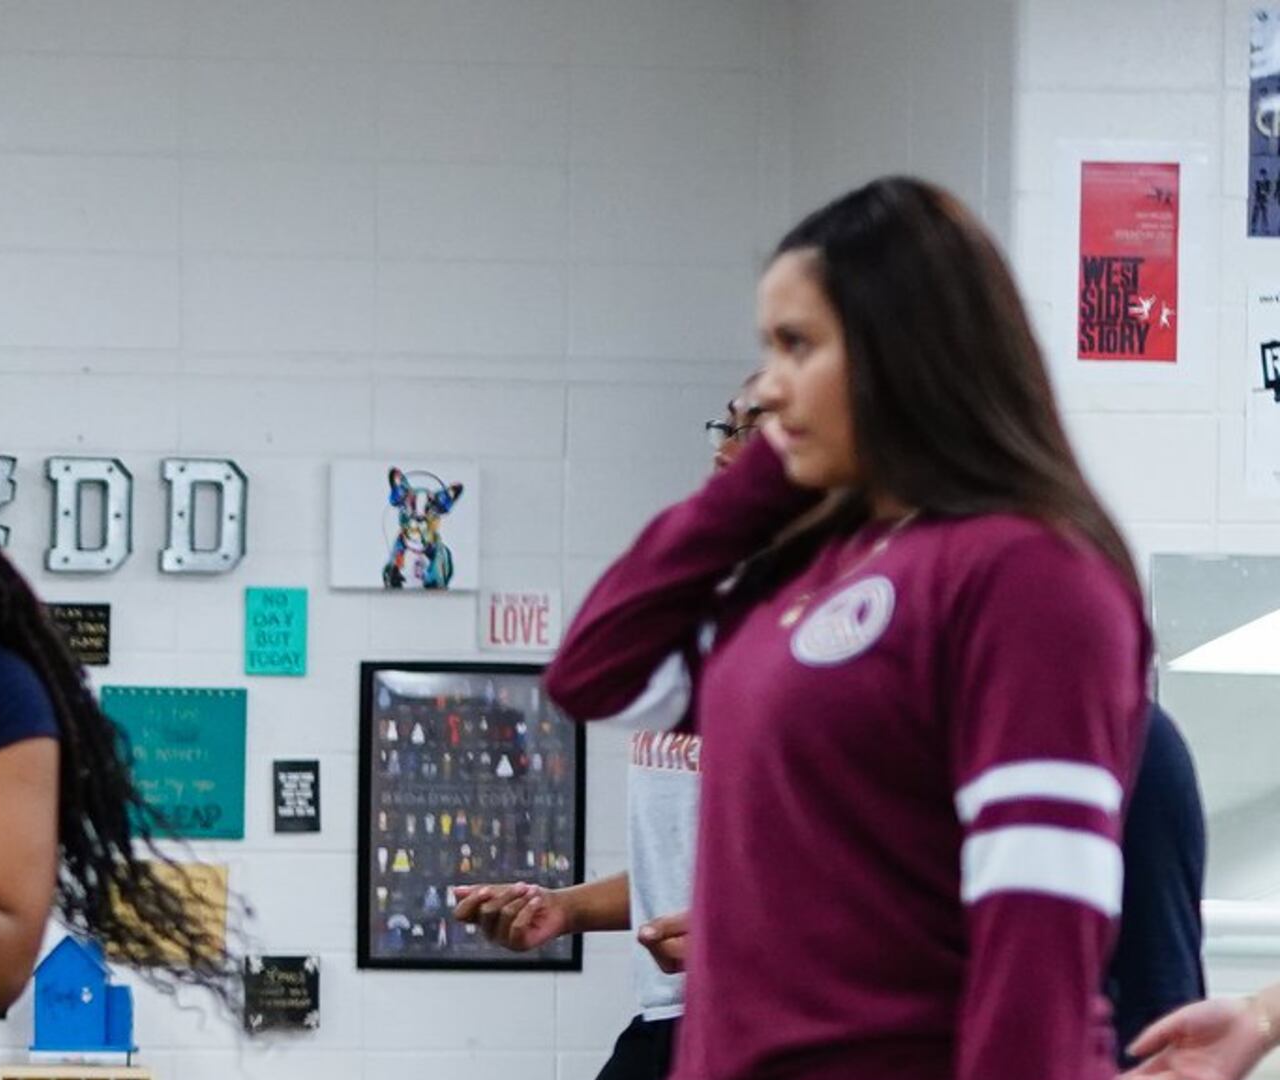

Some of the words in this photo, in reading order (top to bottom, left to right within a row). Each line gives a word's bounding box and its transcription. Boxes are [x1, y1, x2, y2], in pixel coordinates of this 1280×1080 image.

[1081, 256, 1144, 290] WEST
[1081, 287, 1143, 321] SIDE
[1080, 322, 1150, 354] STORY
[263, 591, 288, 608] NO
[253, 610, 294, 627] DAY
[490, 605, 549, 645] LOVE
[256, 629, 290, 647] BUT
[248, 650, 303, 668] TODAY
